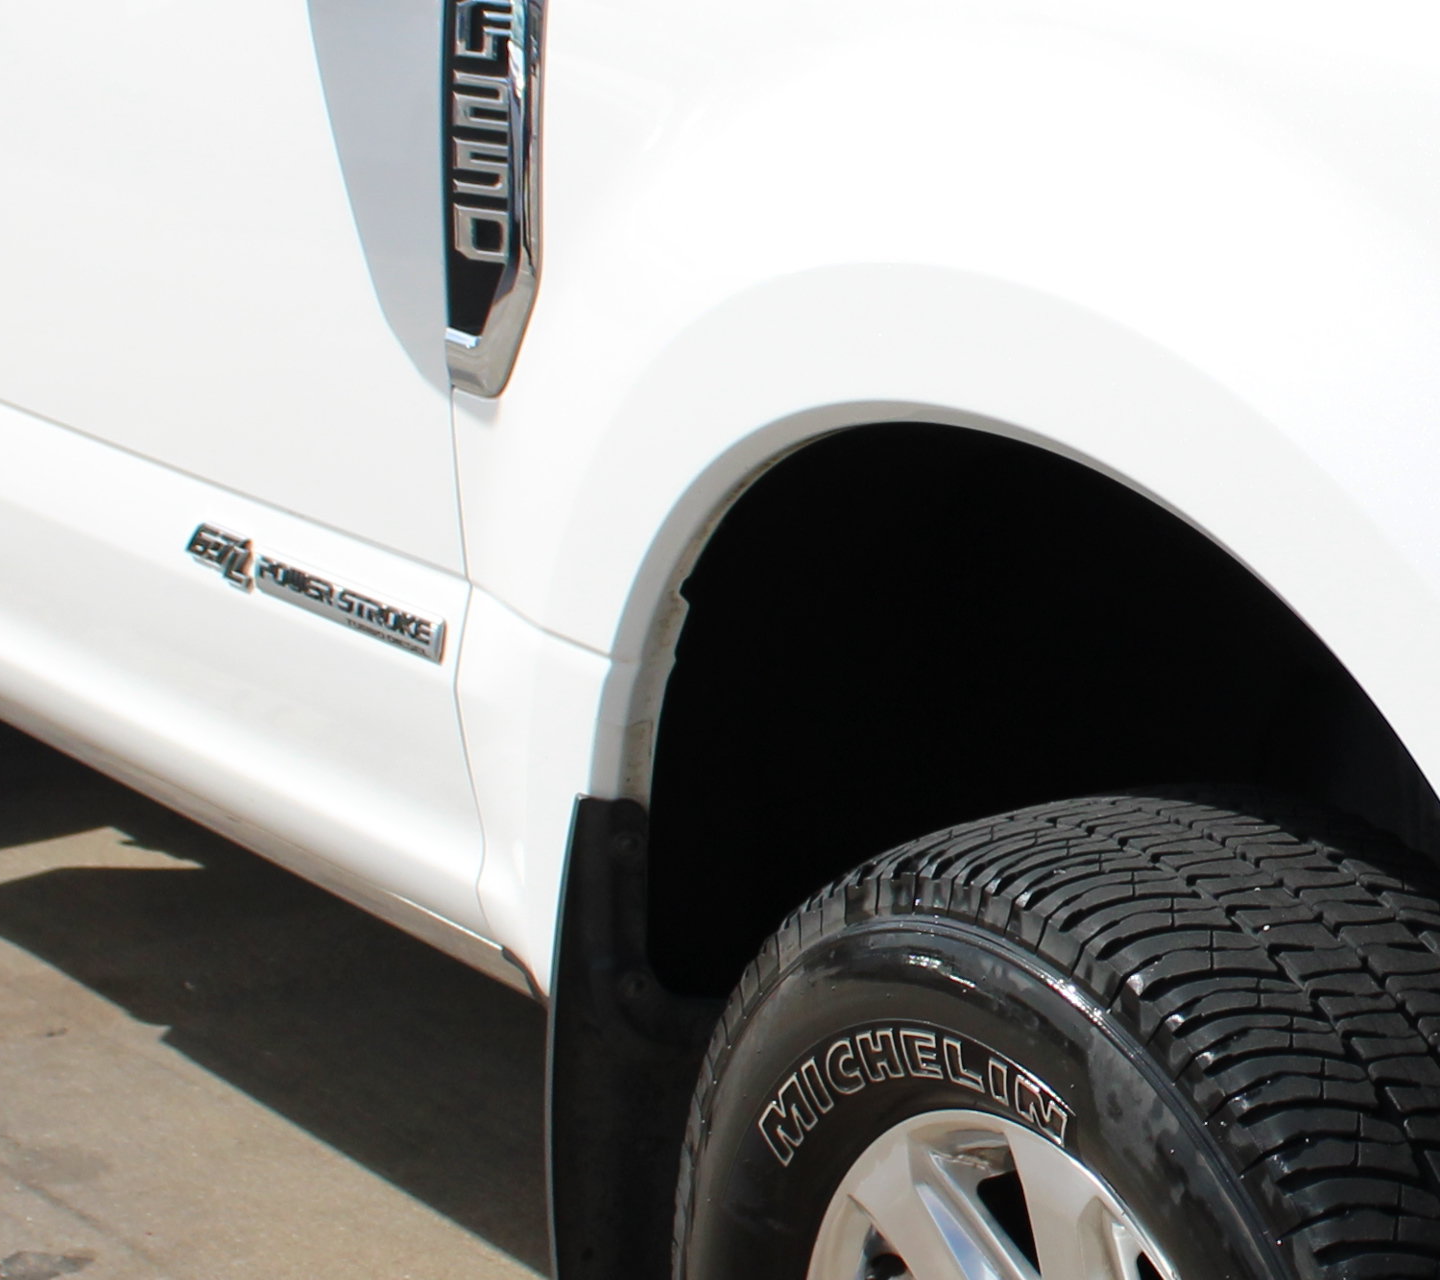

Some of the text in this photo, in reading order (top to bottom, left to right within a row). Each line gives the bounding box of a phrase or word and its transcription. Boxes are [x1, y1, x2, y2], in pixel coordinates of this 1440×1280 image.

[258, 555, 335, 607] POWER
[336, 587, 433, 646] STROKE
[759, 1027, 1068, 1167] MICHELIN
